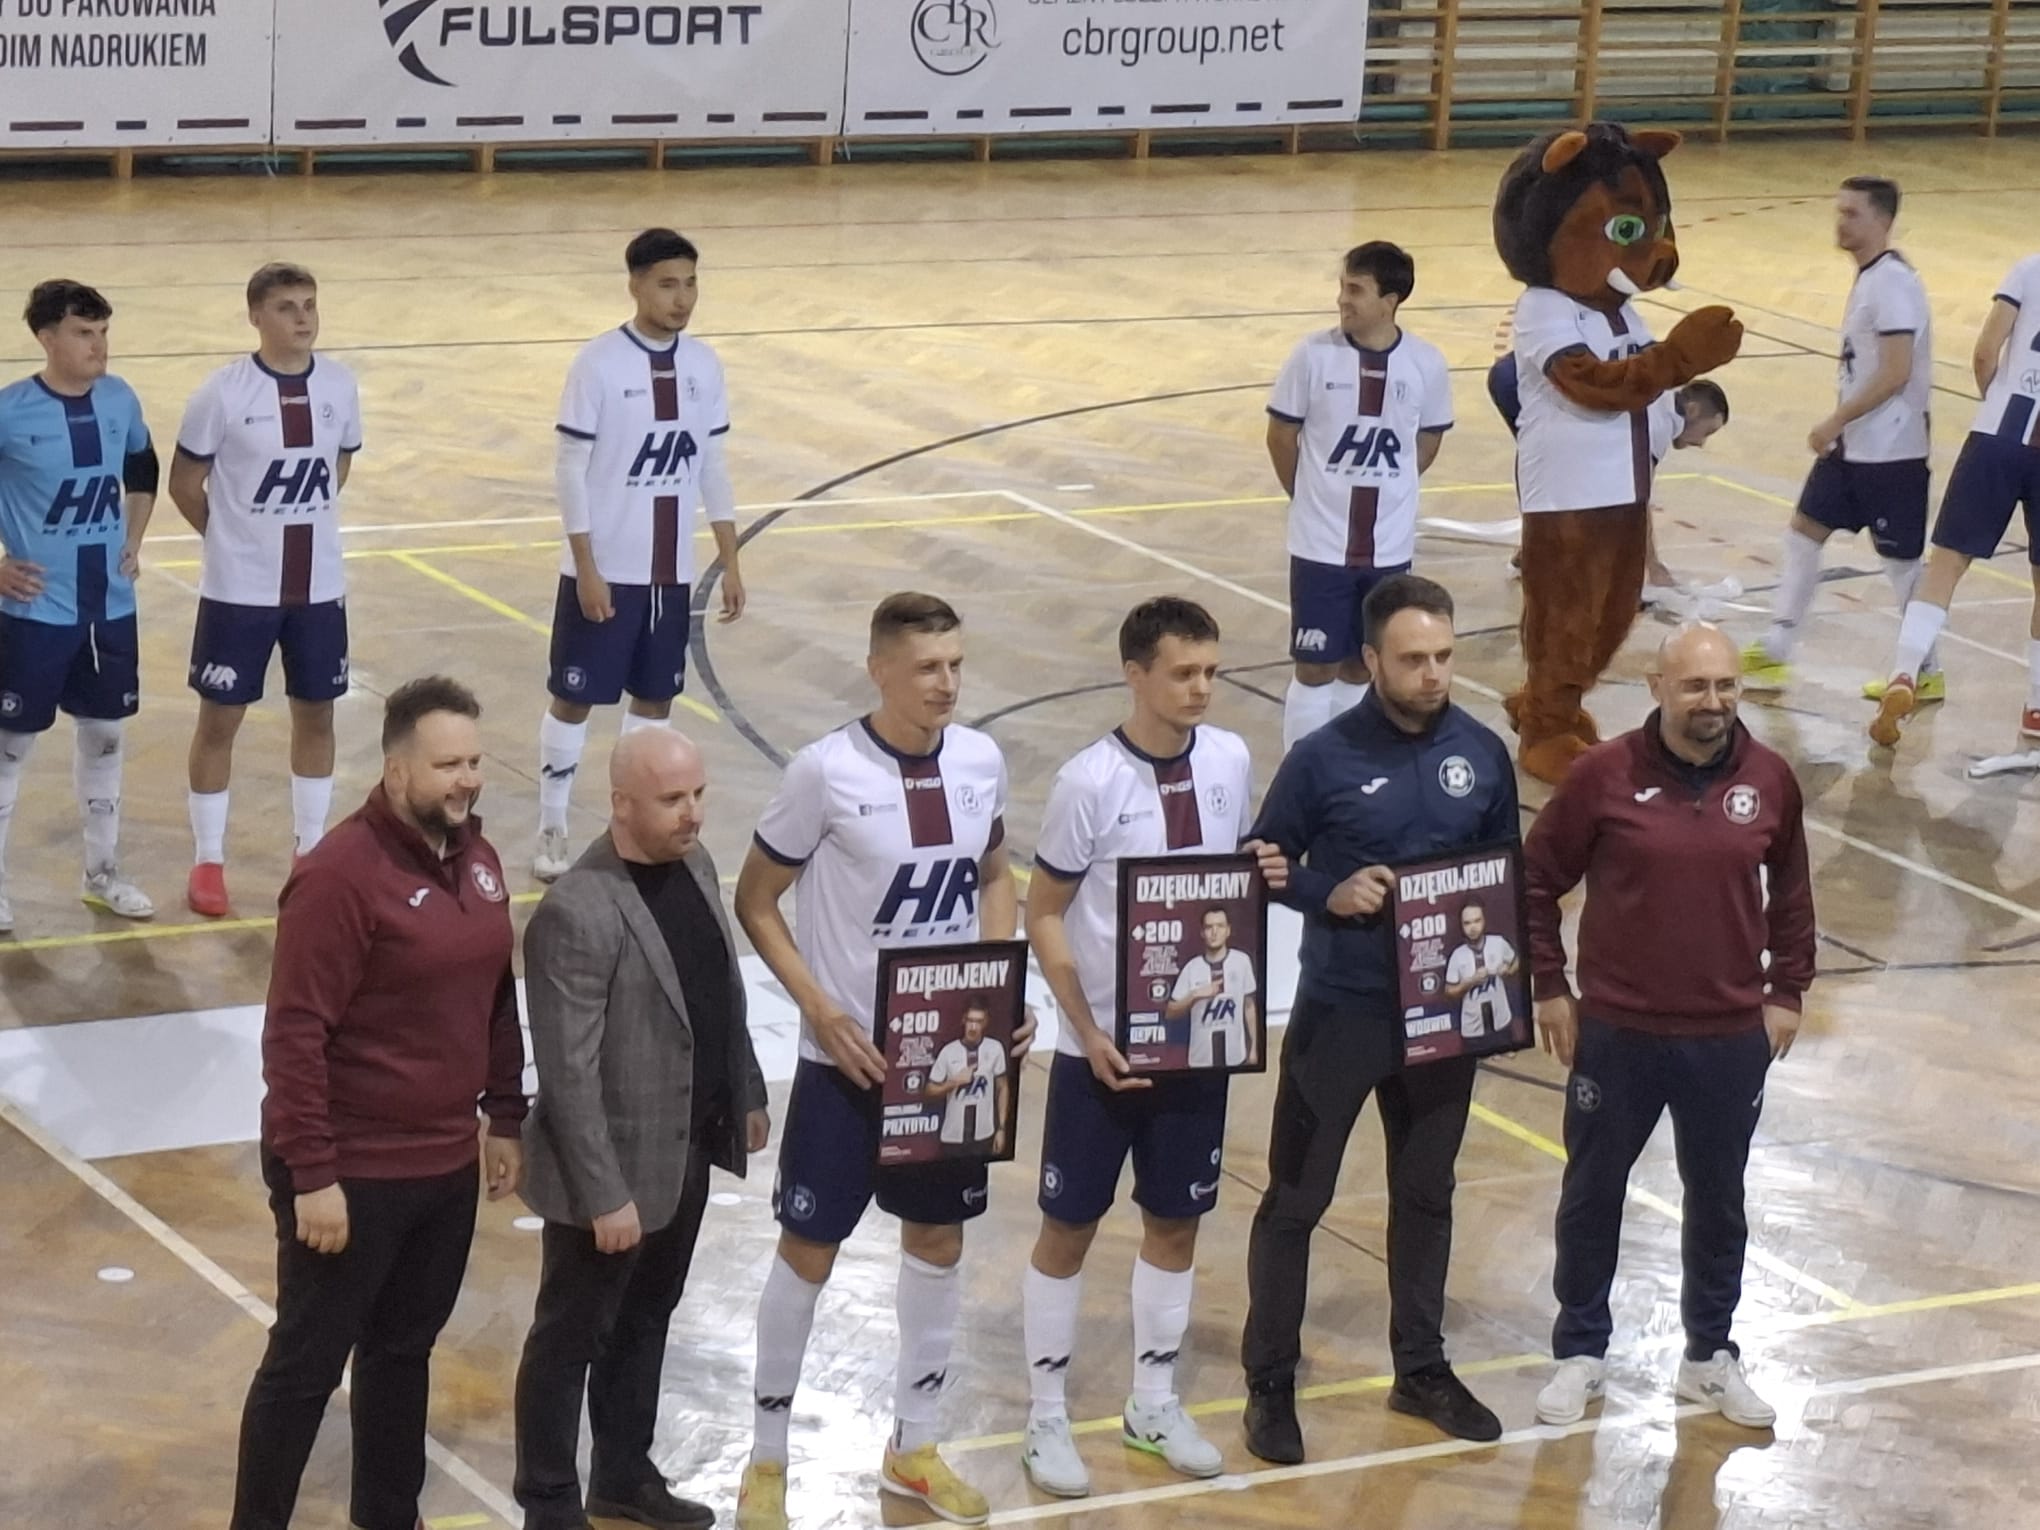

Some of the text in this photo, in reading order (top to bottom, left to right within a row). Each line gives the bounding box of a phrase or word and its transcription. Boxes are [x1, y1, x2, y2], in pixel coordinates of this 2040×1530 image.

[440, 6, 762, 46] FULSPORT
[1062, 17, 1285, 67] cbrgroup.net
[51, 33, 207, 67] NADRUKIEM
[628, 430, 697, 476] HR
[1326, 425, 1401, 469] HR
[44, 474, 121, 525] HR
[252, 457, 330, 504] HR
[872, 857, 979, 925] HR
[1136, 872, 1252, 909] DZIĘKUJEMY
[1400, 858, 1506, 905] DZIĘKUJEMY
[896, 959, 1010, 1000] DZIĘKUJEMY
